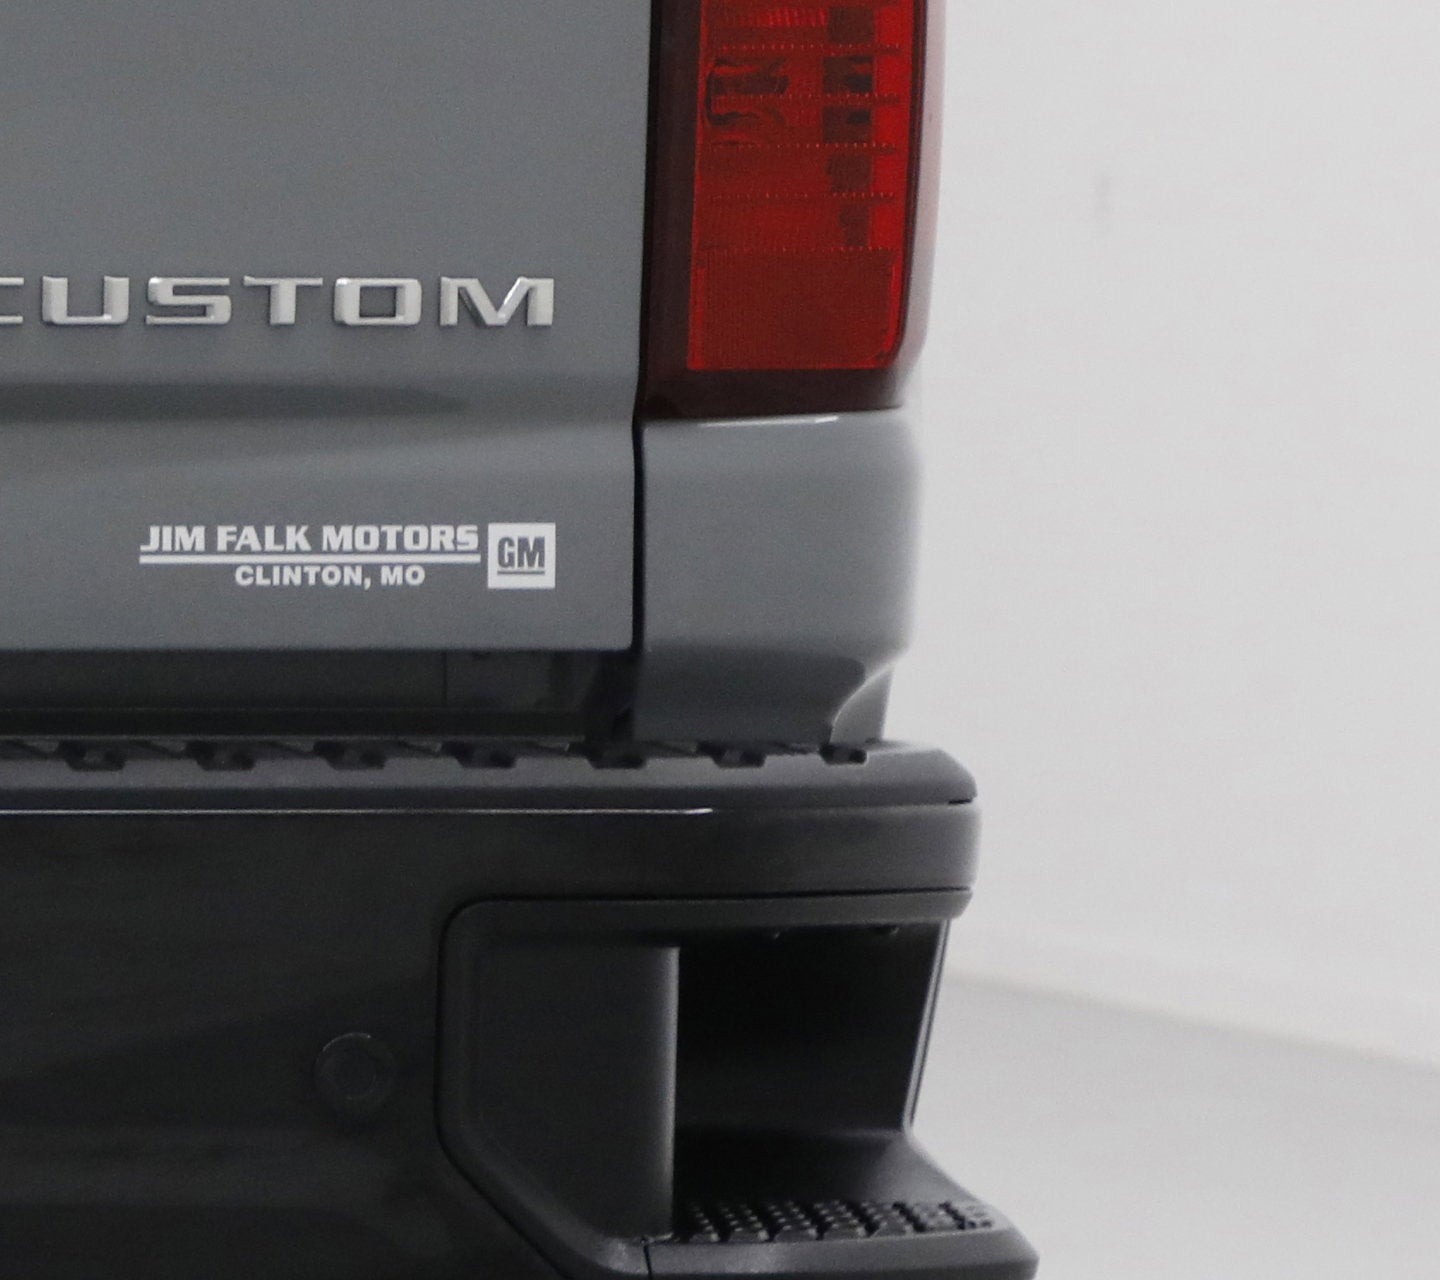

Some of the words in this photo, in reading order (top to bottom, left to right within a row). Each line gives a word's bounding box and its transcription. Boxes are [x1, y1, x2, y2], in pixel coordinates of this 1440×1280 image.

[139, 524, 206, 553] JIM
[215, 524, 313, 553] FALK
[321, 524, 480, 553] MOTORS
[496, 534, 547, 571] GM
[234, 564, 373, 591] CLINTON,
[380, 564, 426, 588] MO
